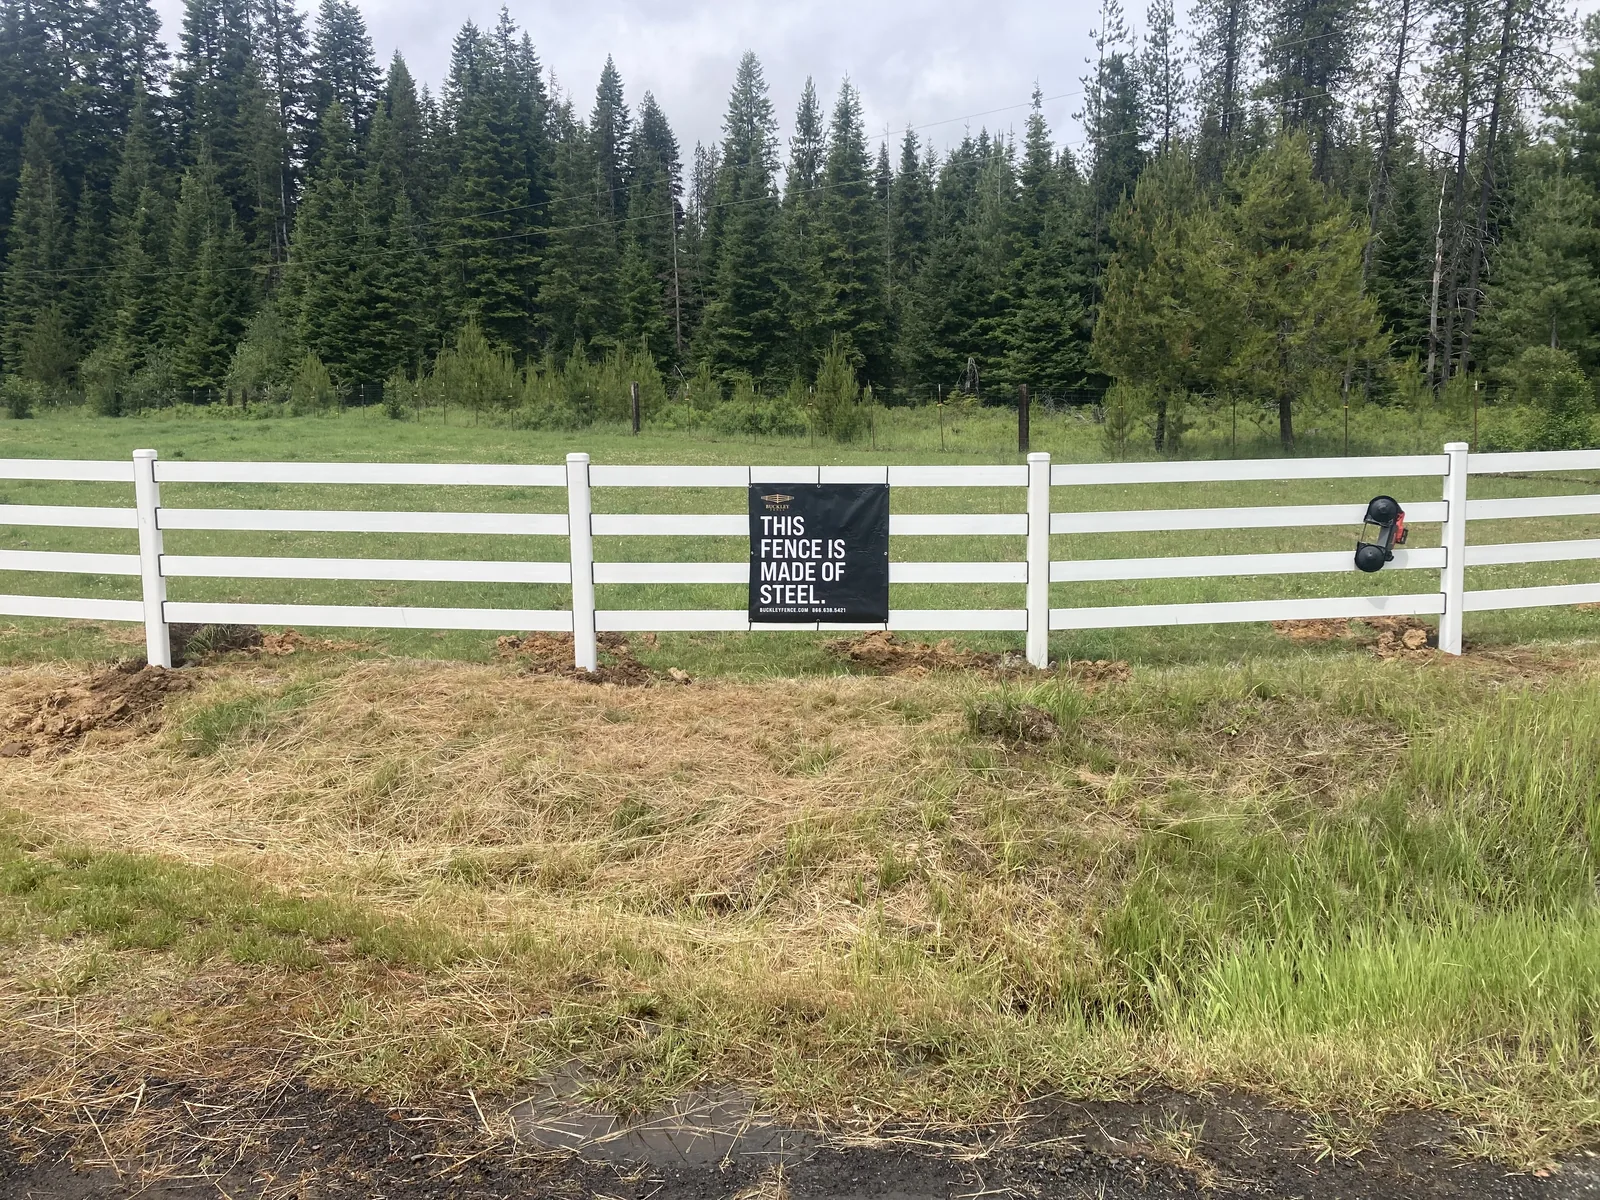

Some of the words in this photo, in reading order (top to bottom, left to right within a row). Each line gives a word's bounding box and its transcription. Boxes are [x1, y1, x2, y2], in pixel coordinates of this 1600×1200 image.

[760, 516, 805, 536] THIS
[761, 539, 822, 559] FENCE
[828, 539, 846, 559] IS
[761, 562, 816, 581] MADE
[822, 562, 846, 582] OF
[760, 584, 826, 605] STEEL.
